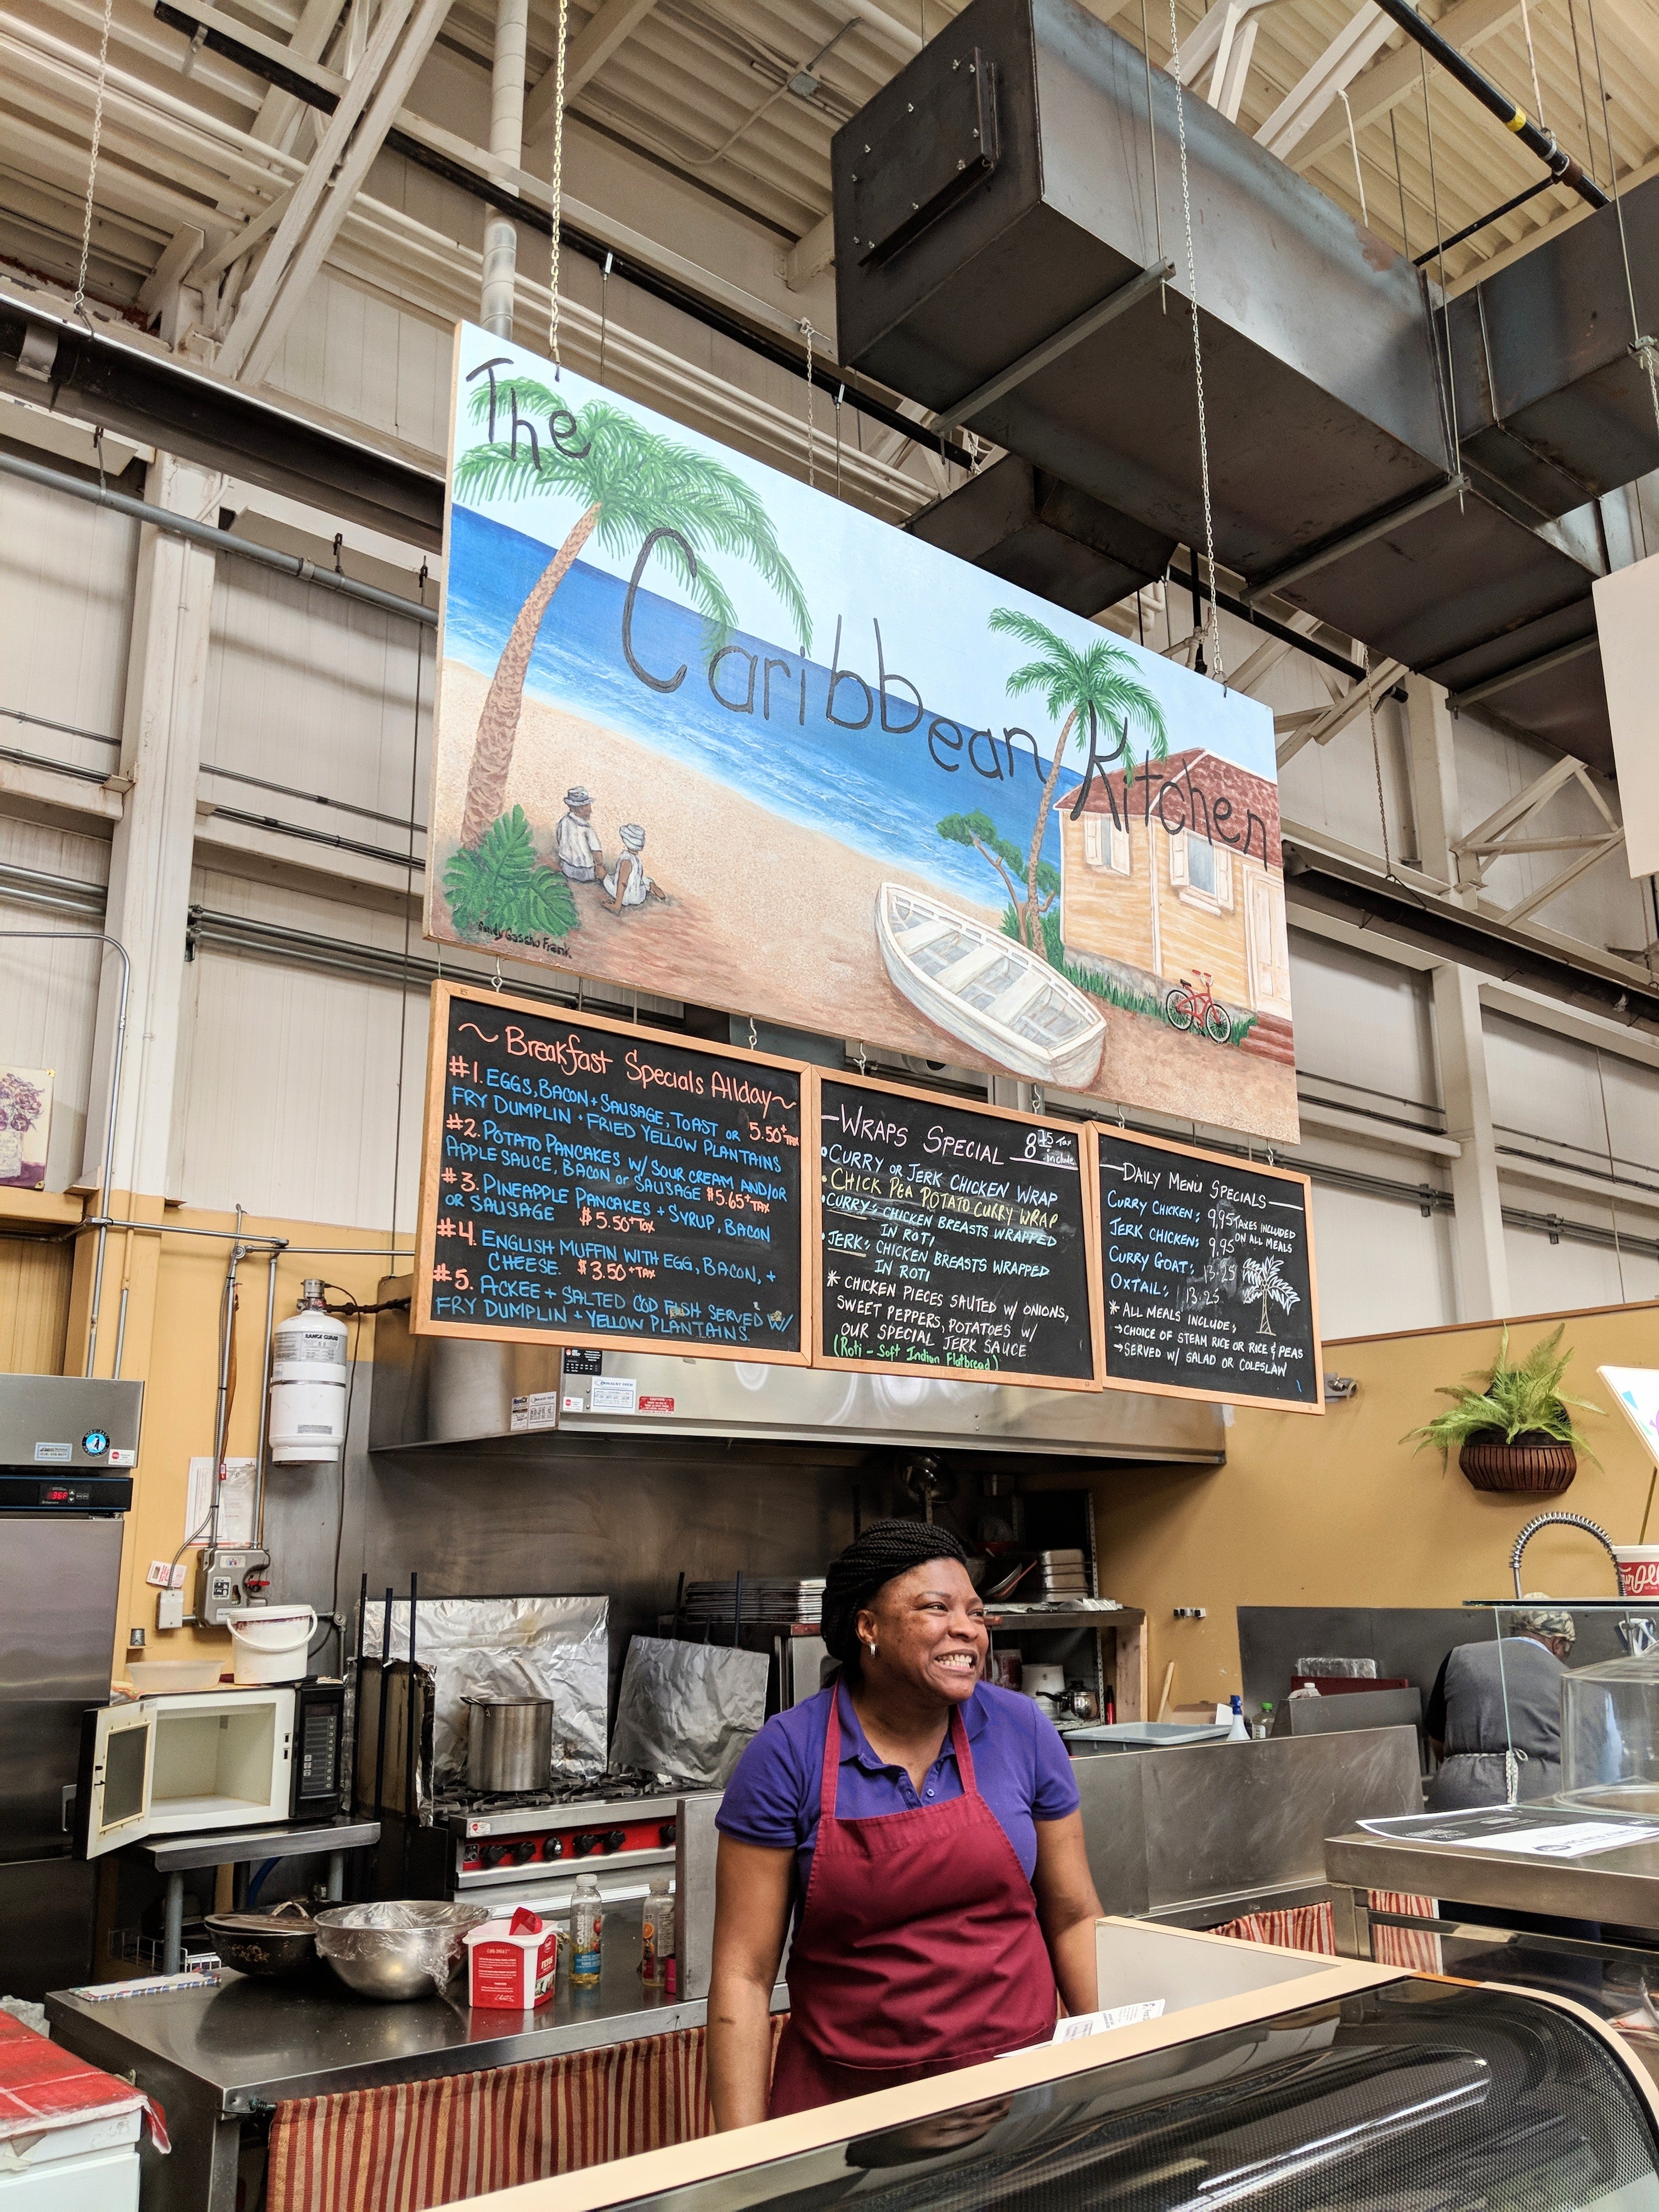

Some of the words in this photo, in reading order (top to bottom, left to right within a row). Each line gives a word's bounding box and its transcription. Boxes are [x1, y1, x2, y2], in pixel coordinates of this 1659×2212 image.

[466, 358, 591, 472] The
[622, 527, 1047, 784] Caribbean
[1070, 699, 1268, 872] Kitchen
[505, 1026, 613, 1075] Breakfast
[625, 1049, 703, 1094] Specials
[712, 1071, 771, 1119] Allday
[452, 1086, 487, 1108] FRY
[494, 1095, 571, 1124] DUMPLIN
[586, 1113, 636, 1138] FRIED
[641, 1125, 697, 1152] YELLOW
[704, 1139, 781, 1172] PLANTAINS
[539, 1079, 588, 1107] BACON
[601, 1093, 669, 1132] SAUSAGE,
[726, 1130, 741, 1141] OR
[483, 1120, 541, 1151] POTATO
[545, 1133, 620, 1166] PANCAKES
[651, 1159, 685, 1181] SOUR
[689, 1170, 733, 1189] CREAM
[842, 1104, 908, 1147] WRAPS
[923, 1126, 1004, 1165] SPECIAL
[447, 1135, 498, 1161] APPLE
[501, 1150, 557, 1175] SAUCE,
[563, 1159, 610, 1182] BACON
[635, 1176, 701, 1201] SAUSAGE
[830, 1144, 884, 1173] CURRY
[890, 1165, 902, 1177] OR
[907, 1164, 943, 1187] JERK
[950, 1174, 1009, 1200] CHICKEN
[1016, 1186, 1058, 1207] WRAP
[1124, 1163, 1161, 1190] DAILY
[1169, 1172, 1202, 1193] MENU
[1210, 1180, 1266, 1209] SPECIALS
[445, 1194, 465, 1206] OR
[470, 1195, 554, 1221] SAUSAGE
[483, 1173, 569, 1204] PINEAPPLE
[575, 1187, 651, 1216] PANCAKES
[669, 1204, 721, 1233] SYRUP,
[724, 1218, 770, 1242] BACON
[831, 1167, 882, 1194] CHICK
[920, 1187, 970, 1212] POTATO
[973, 1201, 1013, 1226] CURRY
[1020, 1209, 1058, 1228] WRAP
[1108, 1190, 1148, 1216] CURRY
[881, 1224, 898, 1238] IN
[903, 1229, 935, 1247] ROTI
[883, 1207, 933, 1228] CHICKEN
[938, 1216, 989, 1238] BREASTS
[994, 1228, 1057, 1246] WRAPPED
[1110, 1217, 1143, 1239] JERK
[1233, 1216, 1257, 1231] TAXES
[1261, 1223, 1295, 1239] INCLUDED
[1235, 1233, 1246, 1244] ON
[1249, 1234, 1263, 1245] ALL
[1266, 1238, 1292, 1253] MEALS
[482, 1229, 555, 1254] ENGLISH
[560, 1239, 617, 1261] MUFFIN
[624, 1248, 659, 1265] WITH
[663, 1254, 699, 1274] EGG,
[702, 1257, 762, 1285] BACON,
[874, 1260, 893, 1276] IN
[900, 1265, 930, 1282] ROTI
[876, 1240, 928, 1262] CHICKEN
[934, 1251, 987, 1273] BREASTS
[993, 1260, 1049, 1277] WRAPPED
[1109, 1245, 1149, 1272] CURRY
[436, 1296, 477, 1314] FRY
[486, 1300, 567, 1323] DUMPLIN
[585, 1311, 644, 1329] YELLOW
[481, 1275, 540, 1299] ACKEE
[562, 1285, 625, 1308] SALTED
[633, 1294, 658, 1313] COD
[664, 1300, 701, 1318] FISH
[708, 1304, 763, 1327] SERVED
[837, 1295, 882, 1317] SWEET
[888, 1306, 945, 1333] PEPPERS,
[949, 1318, 1011, 1338] POTATOES
[845, 1276, 896, 1297] CHICKEN
[904, 1286, 943, 1306] PIECES
[950, 1294, 996, 1313] SAUTED
[1023, 1304, 1069, 1323] ONIONS,
[1122, 1302, 1143, 1317] ALL
[1147, 1305, 1183, 1322] MEALS
[841, 1323, 868, 1339] OUR
[877, 1324, 935, 1346] SPECIAL
[943, 1335, 977, 1353] JERK
[984, 1339, 1026, 1357] SAUCE
[877, 1344, 900, 1358] Soft
[907, 1346, 939, 1361] Indian
[1124, 1325, 1155, 1339] CHOICE
[1160, 1330, 1172, 1340] OF
[1177, 1333, 1207, 1347] STEAM
[1212, 1337, 1229, 1349] RICE
[1233, 1341, 1244, 1352] OR
[1249, 1342, 1268, 1354] RICE
[1278, 1346, 1303, 1359] PEAS
[1125, 1342, 1161, 1357] SERVED
[1186, 1351, 1216, 1365] SALAD
[1222, 1357, 1234, 1368] OR
[1239, 1359, 1287, 1377] COLESLAW
